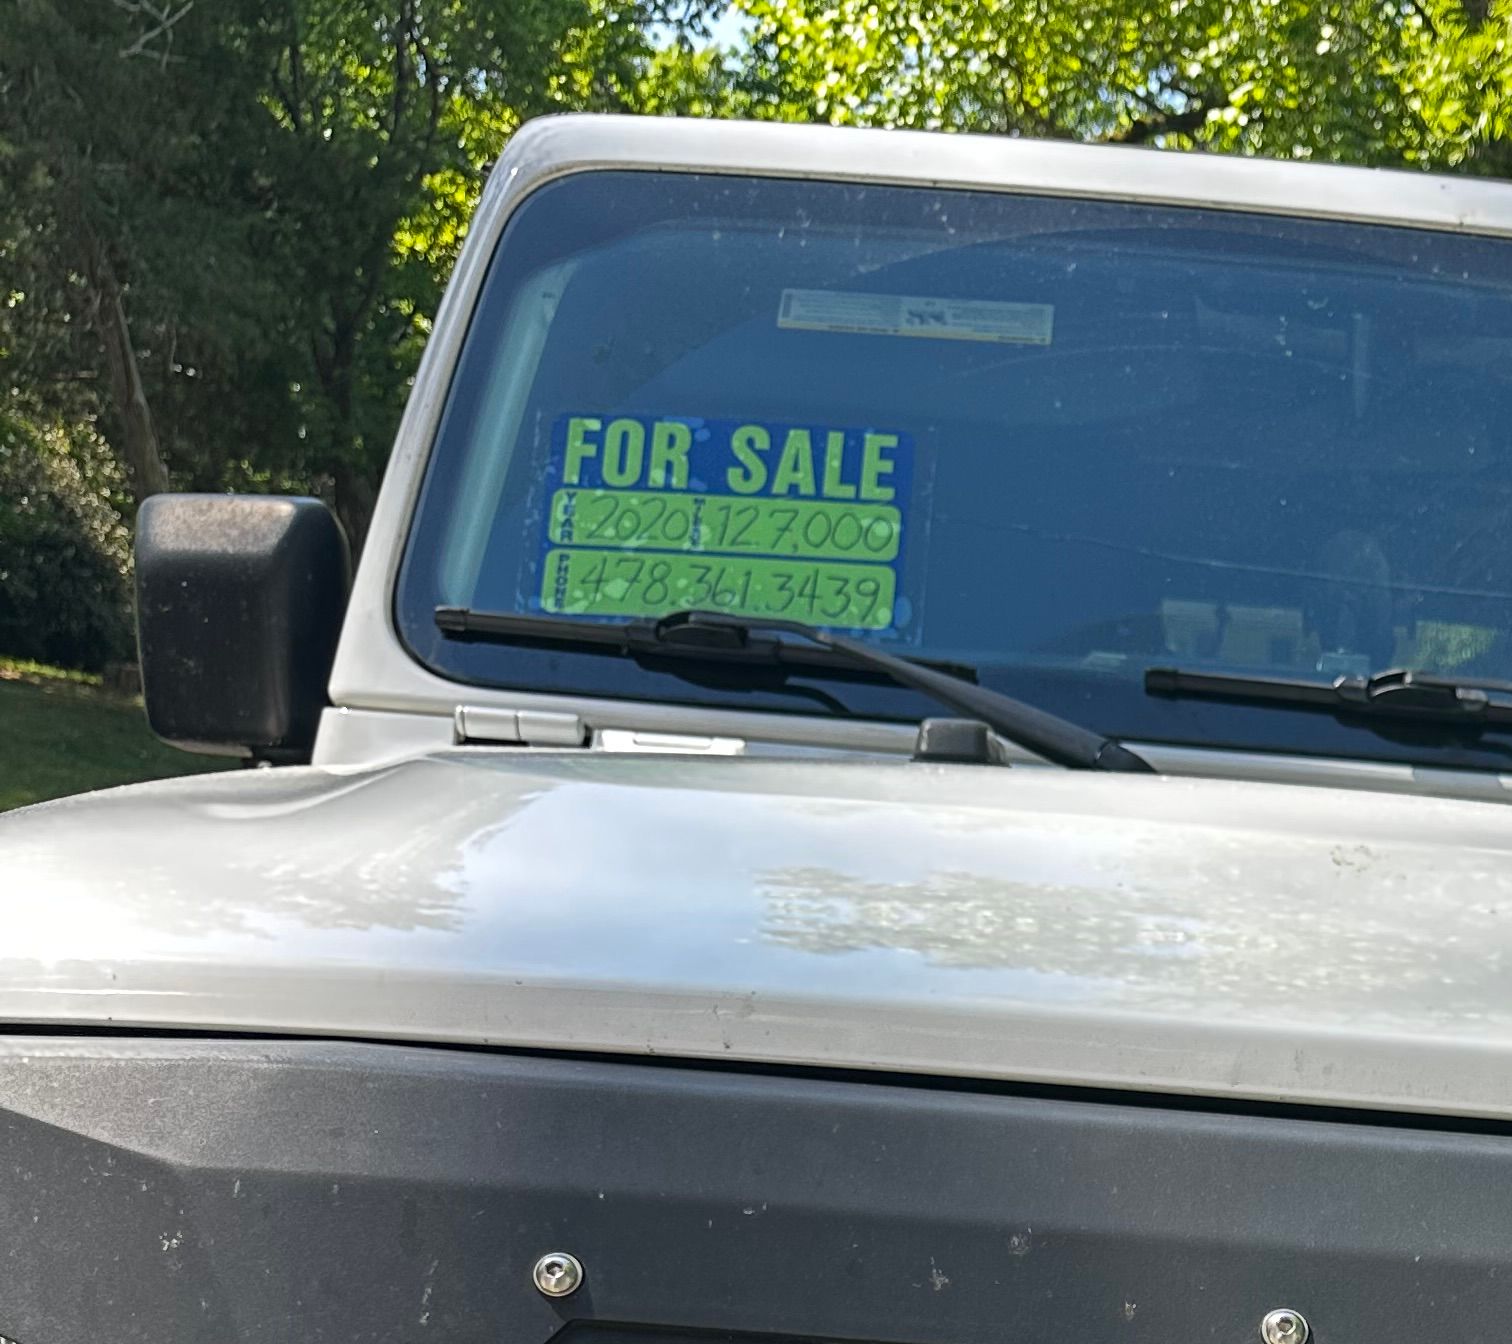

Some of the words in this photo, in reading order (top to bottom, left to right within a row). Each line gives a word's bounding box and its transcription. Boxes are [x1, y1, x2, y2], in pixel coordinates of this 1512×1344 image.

[563, 417, 692, 489] FOR
[727, 425, 899, 500] SALE
[560, 492, 577, 542] YEAR
[586, 496, 690, 541] 2020
[717, 505, 894, 553] 127,000
[554, 554, 571, 608] PHONE
